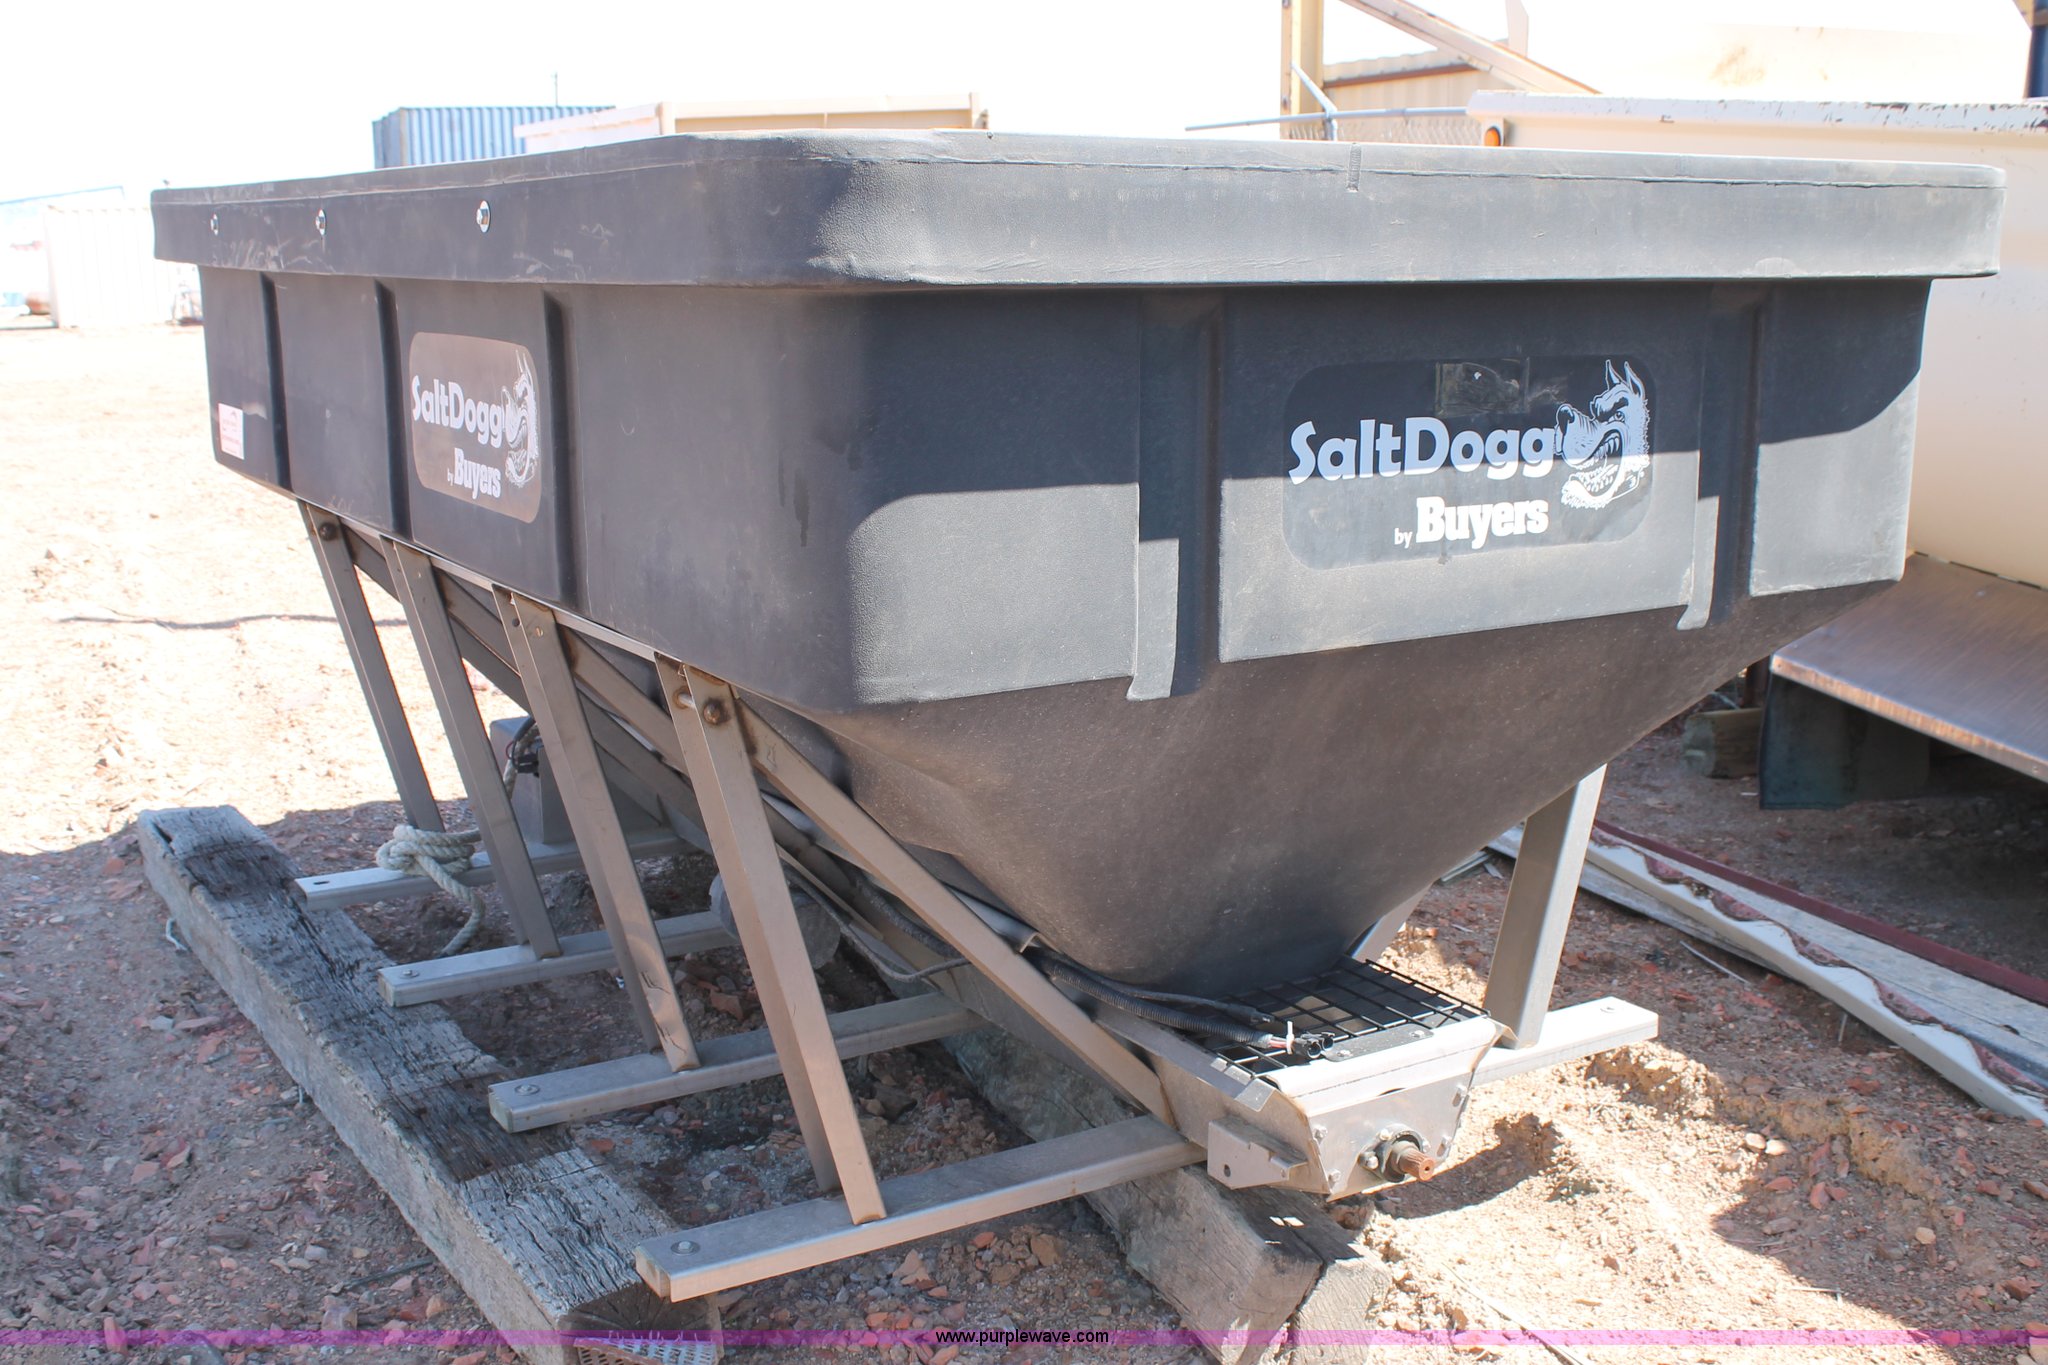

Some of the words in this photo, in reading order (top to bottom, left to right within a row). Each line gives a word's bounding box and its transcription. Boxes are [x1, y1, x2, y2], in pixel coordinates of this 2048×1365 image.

[412, 375, 503, 448] SaltDogg
[454, 447, 501, 499] Buyers
[1288, 416, 1555, 485] SaltDogg
[1394, 527, 1412, 548] by
[1416, 496, 1549, 549] Buyers
